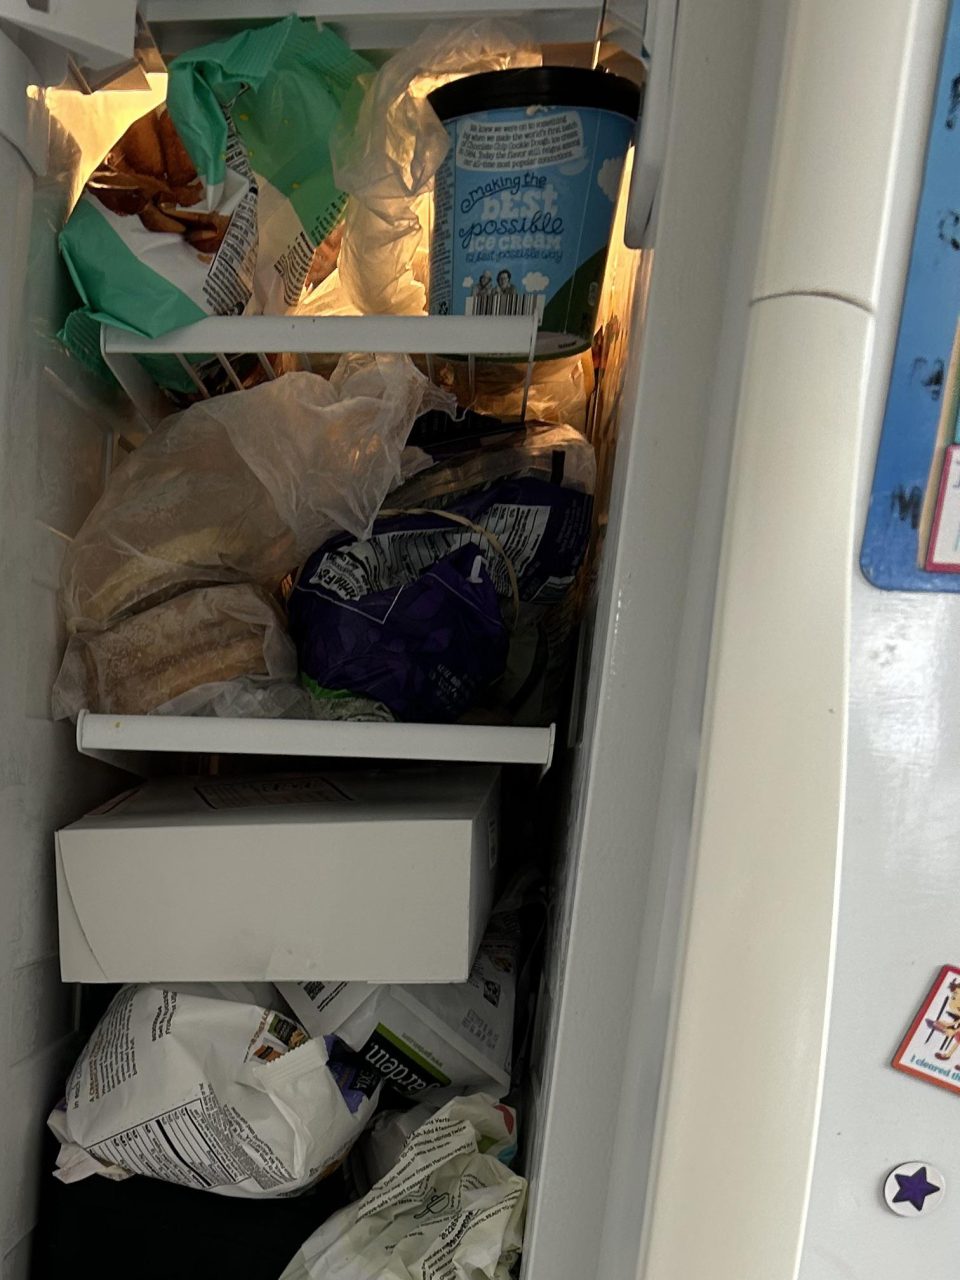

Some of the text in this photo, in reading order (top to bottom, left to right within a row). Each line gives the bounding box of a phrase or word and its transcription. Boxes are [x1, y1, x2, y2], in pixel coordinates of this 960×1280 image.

[464, 172, 547, 204] making the
[459, 211, 564, 248] possible
[365, 1042, 440, 1096] ardein
[915, 1057, 950, 1078] cleared
